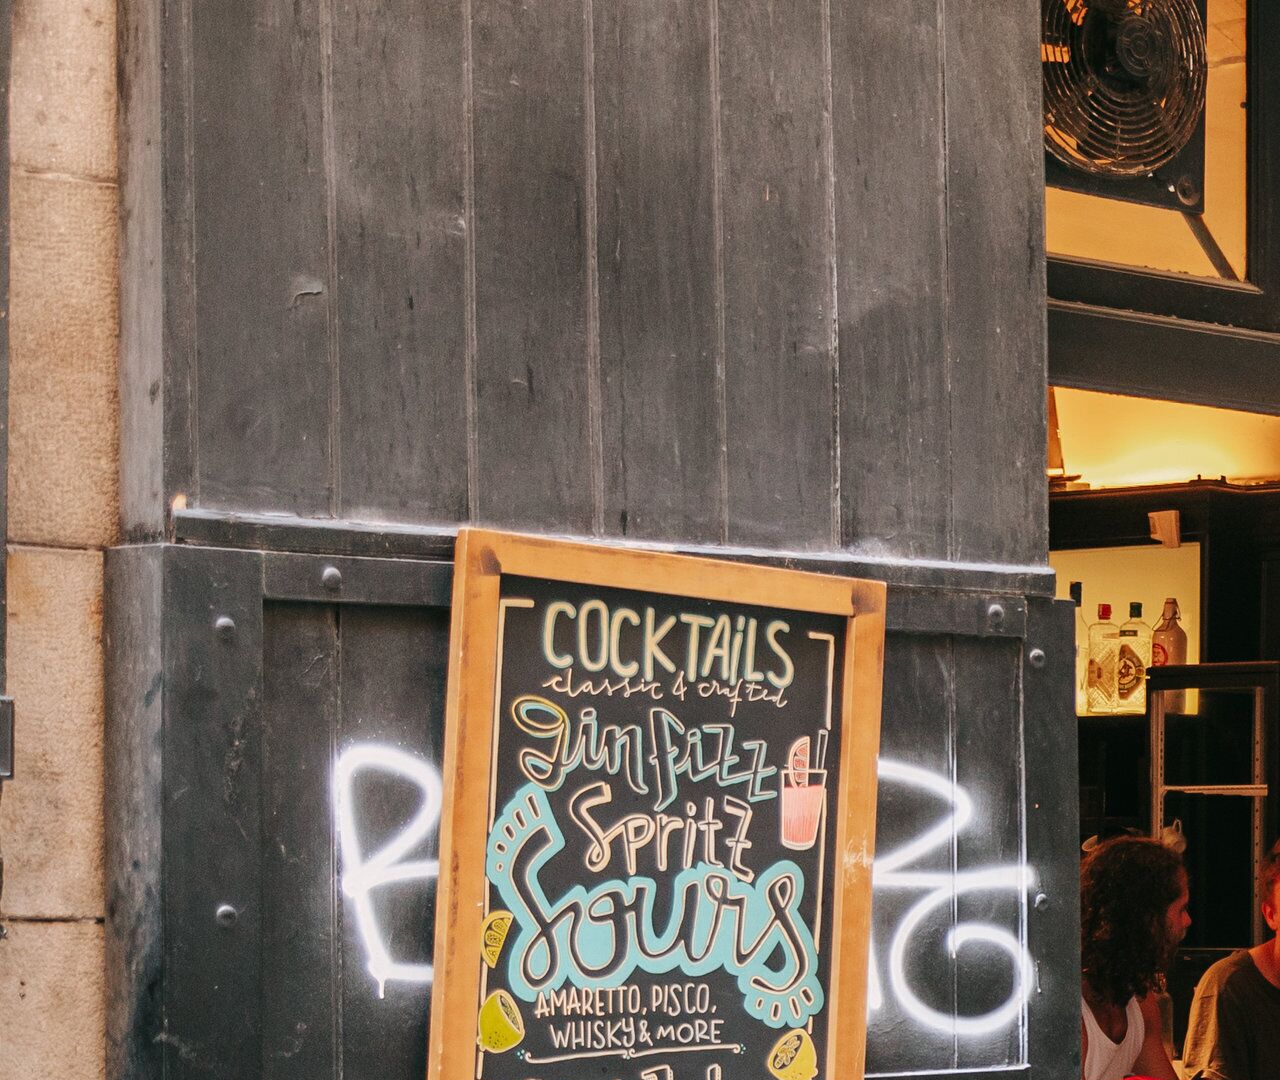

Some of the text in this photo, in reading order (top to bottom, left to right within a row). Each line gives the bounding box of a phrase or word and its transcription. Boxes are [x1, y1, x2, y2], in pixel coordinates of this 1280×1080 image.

[542, 669, 662, 699] classic
[698, 677, 788, 717] crafted
[510, 823, 812, 995] Sours
[535, 983, 717, 1019] AMARETTO, PISCO,
[550, 1019, 637, 1049] WHISKY
[657, 1019, 725, 1045] MORE
